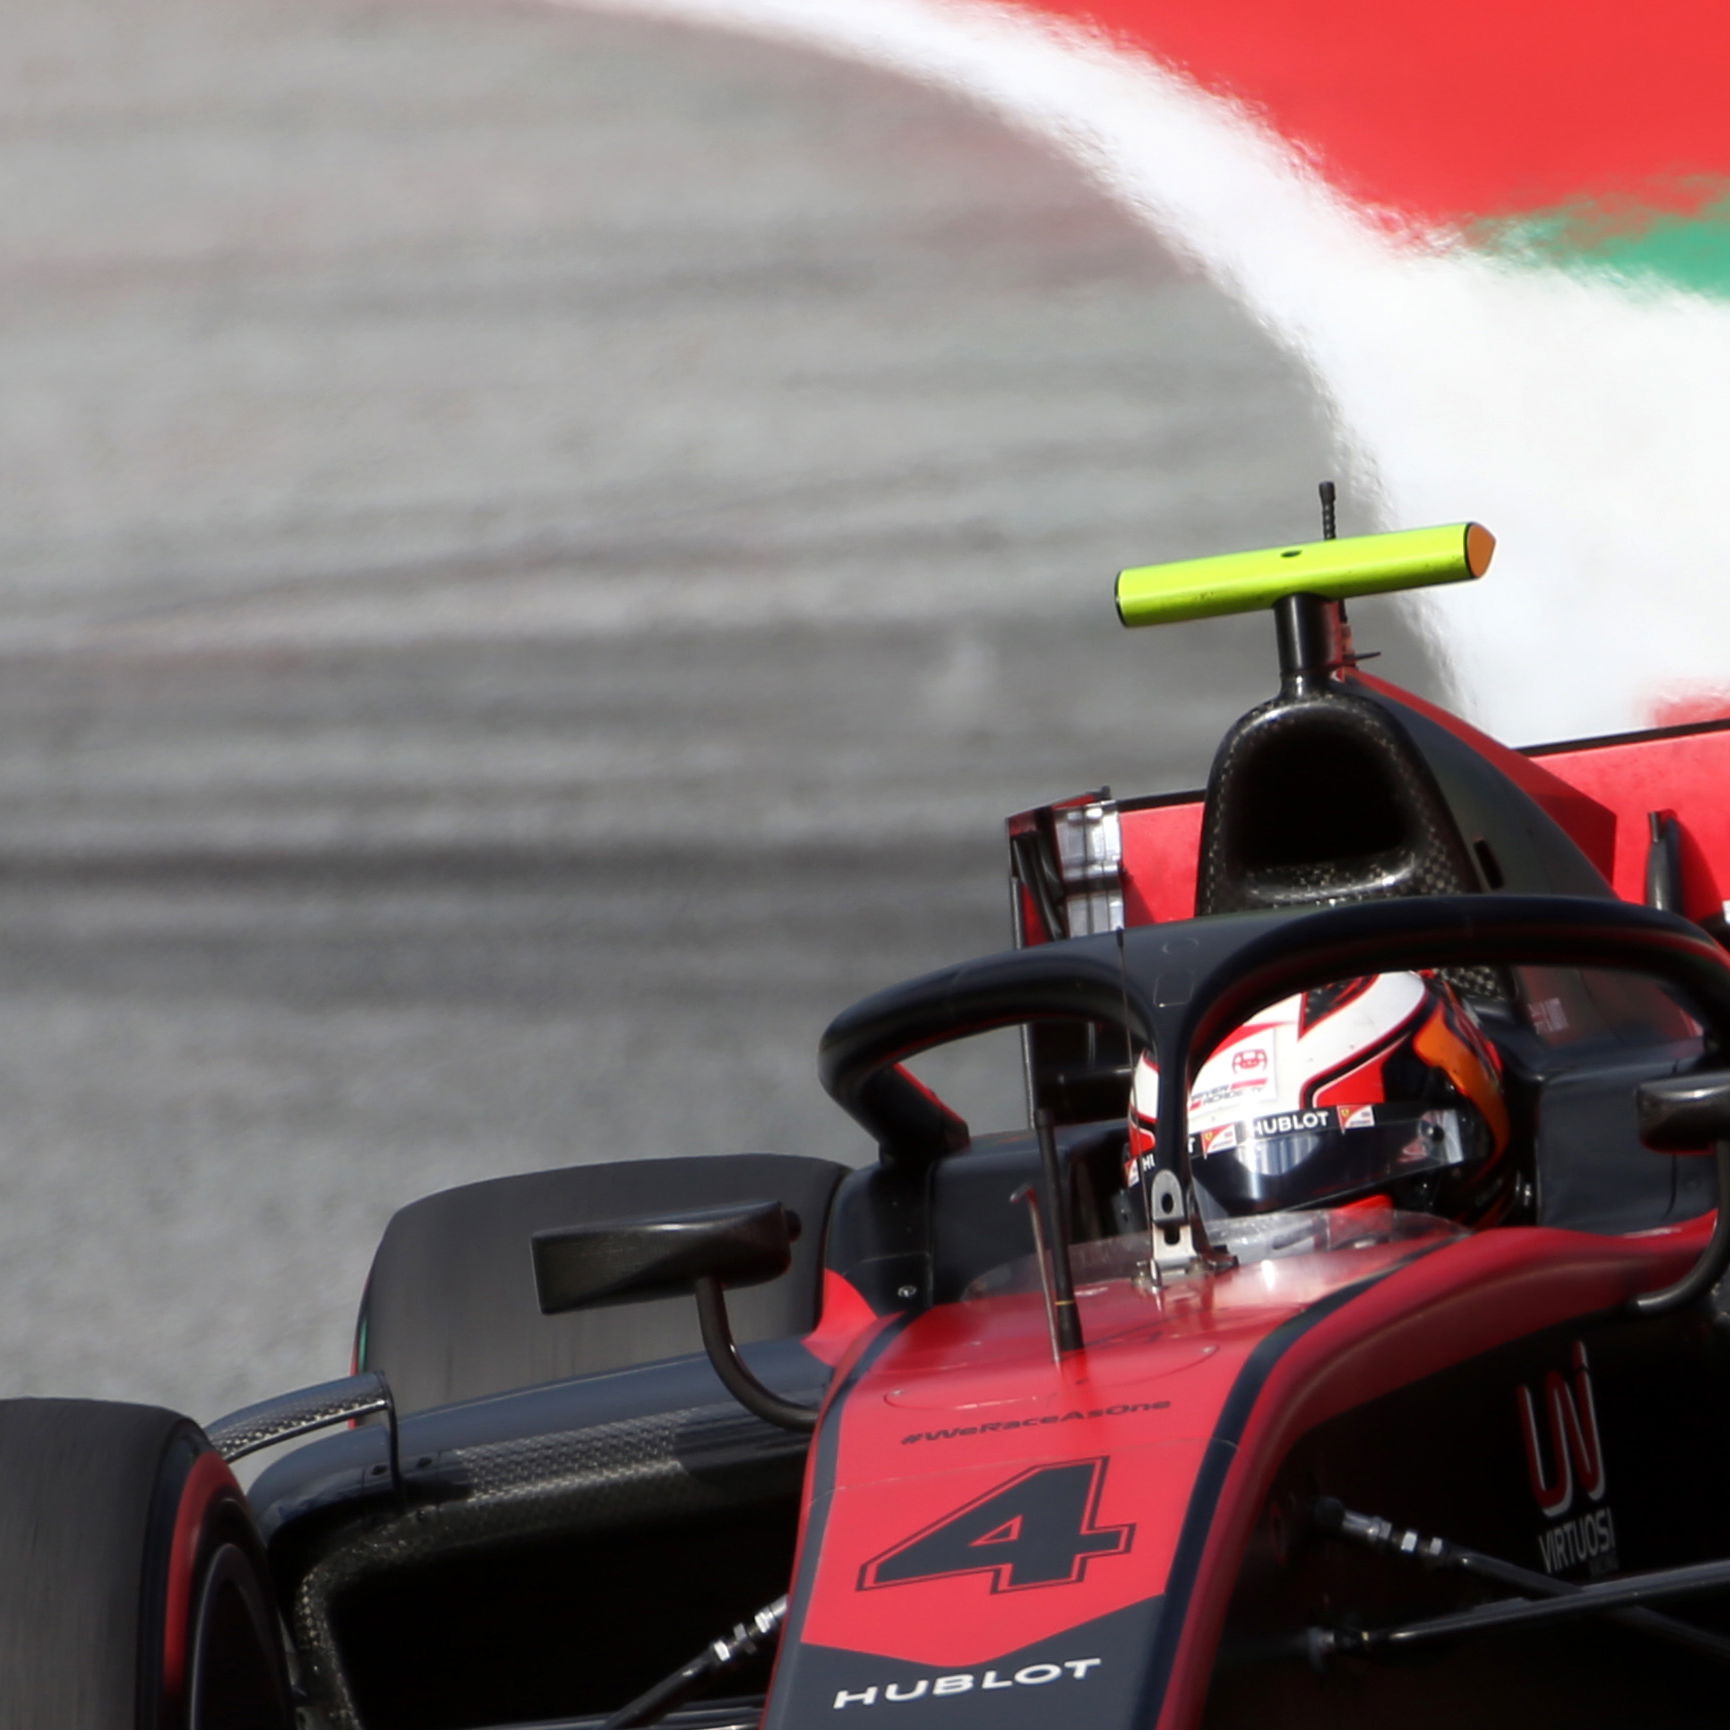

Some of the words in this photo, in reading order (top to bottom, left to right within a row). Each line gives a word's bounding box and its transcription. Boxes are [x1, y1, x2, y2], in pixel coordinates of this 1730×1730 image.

[1253, 1110, 1329, 1137] HUBLOT
[901, 1400, 1171, 1446] #WeRaceAsOne
[855, 1455, 1136, 1595] 4
[1538, 1506, 1617, 1575] VIRTUOSI
[833, 1657, 1102, 1710] HUBLOT
